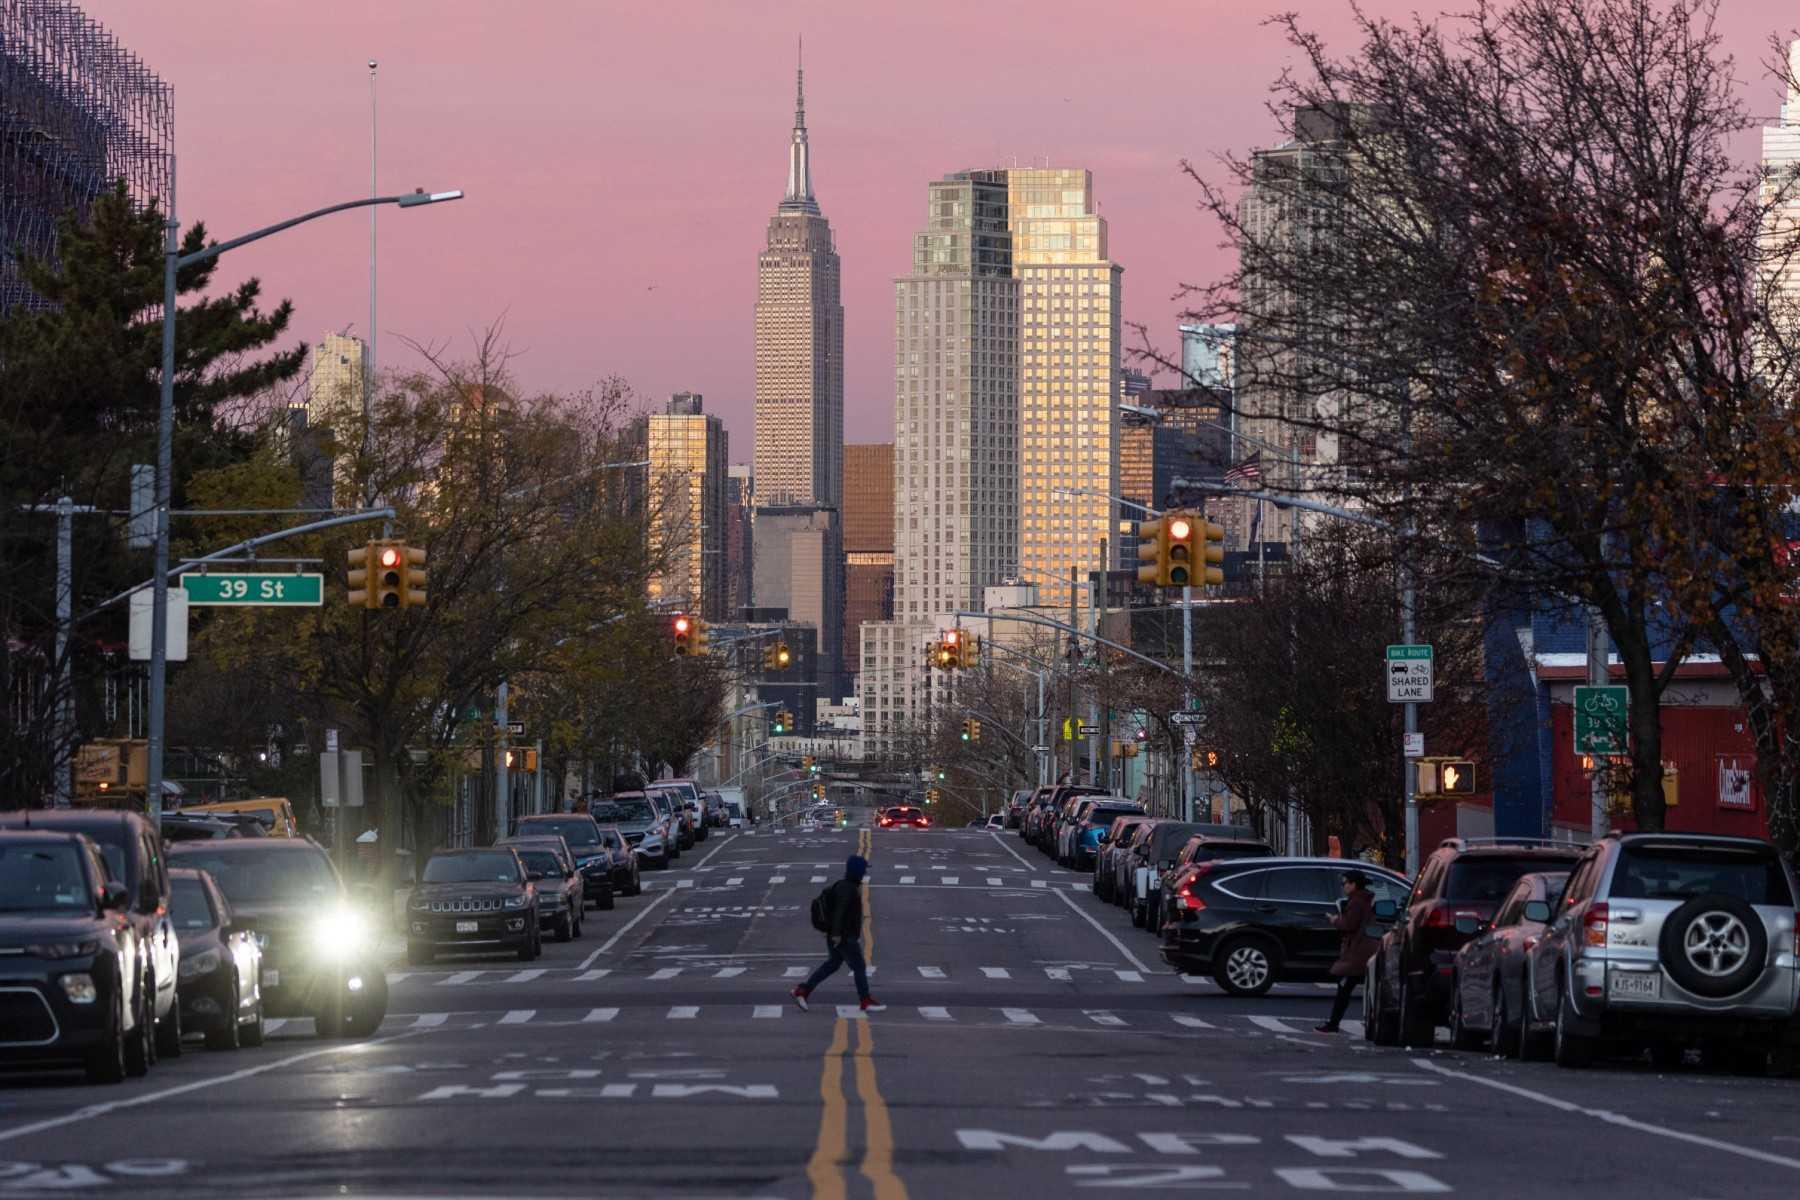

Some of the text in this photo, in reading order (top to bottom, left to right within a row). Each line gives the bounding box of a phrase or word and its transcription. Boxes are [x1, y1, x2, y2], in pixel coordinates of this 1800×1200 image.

[219, 579, 285, 598] 39 St
[1391, 677, 1429, 686] SHARED
[1398, 688, 1423, 697] LANE
[417, 1083, 779, 1100] MPH
[955, 1129, 1447, 1160] MPH
[1064, 1164, 1456, 1193] 20
